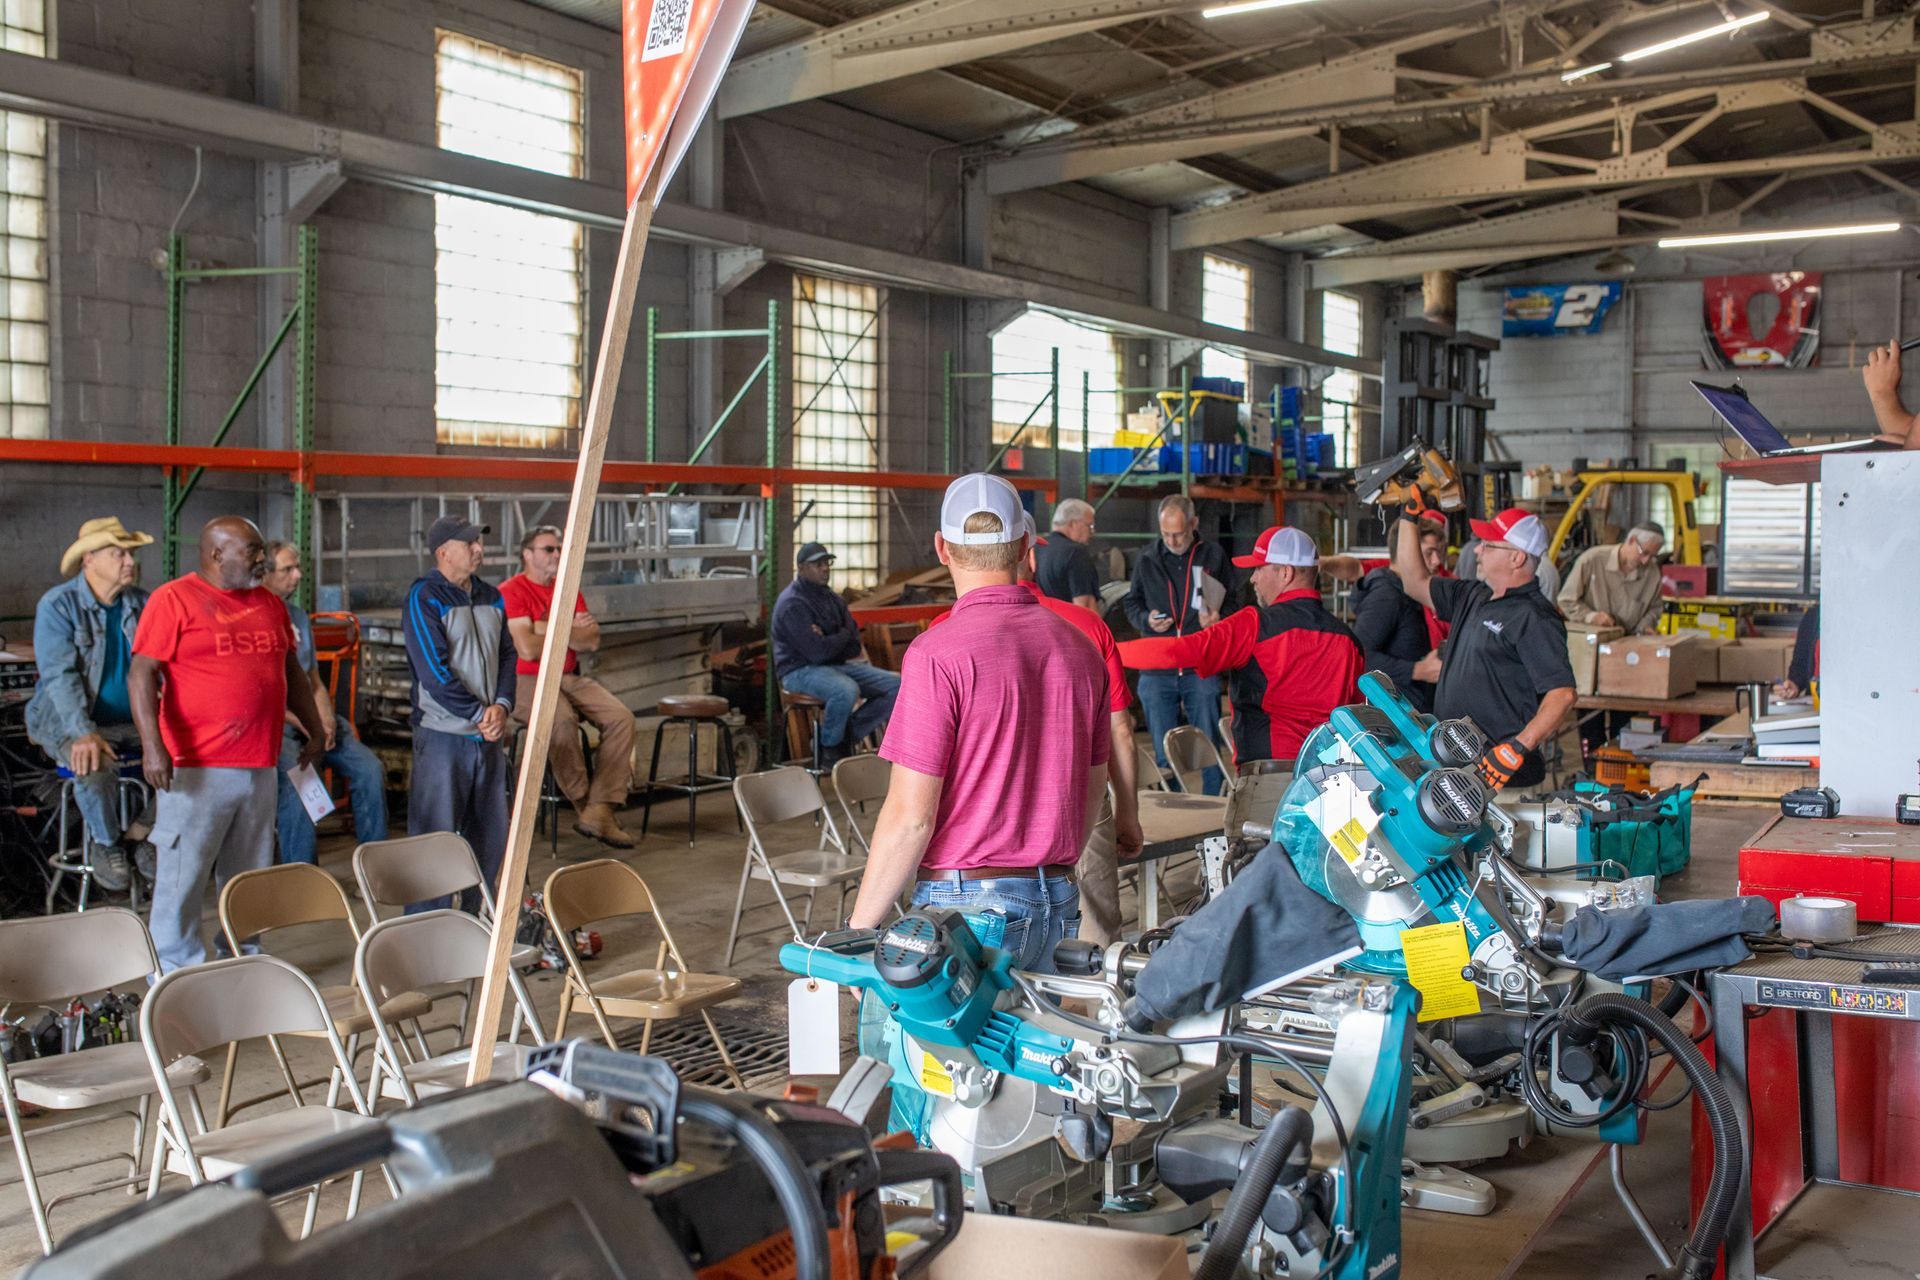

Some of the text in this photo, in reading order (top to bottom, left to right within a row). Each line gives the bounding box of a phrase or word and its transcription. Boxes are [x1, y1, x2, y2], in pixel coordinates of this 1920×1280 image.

[1554, 285, 1605, 328] 2
[1484, 473, 1495, 519] YSTER
[1777, 989, 1822, 1001] BRETFORD
